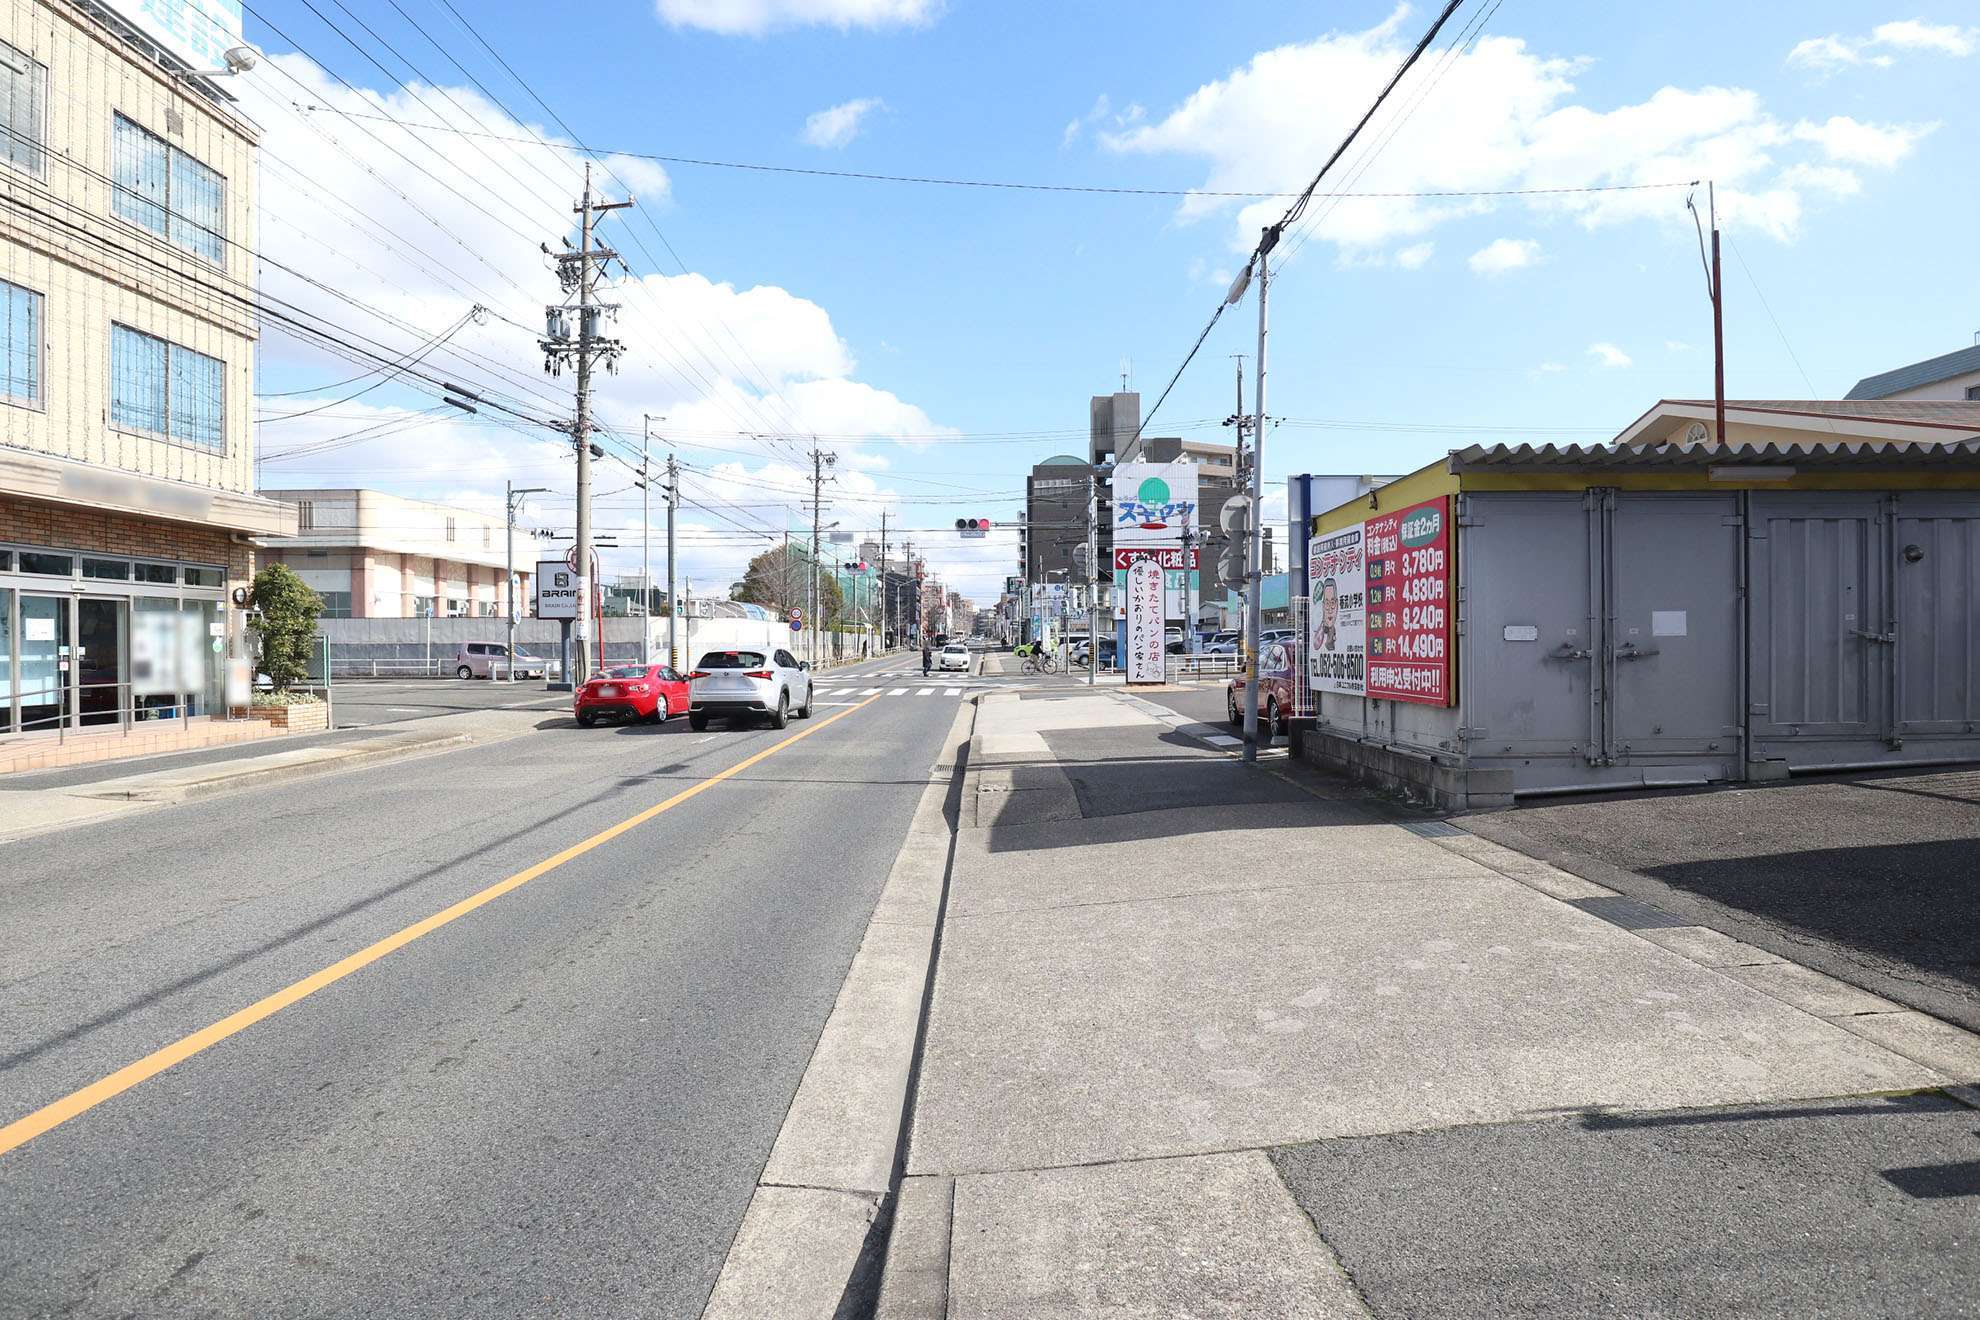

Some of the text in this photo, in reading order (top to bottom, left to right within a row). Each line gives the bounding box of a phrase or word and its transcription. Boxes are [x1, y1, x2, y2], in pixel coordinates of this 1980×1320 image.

[1402, 547, 1444, 577] 3,780円
[1402, 576, 1444, 605] 4,830円
[1148, 568, 1160, 662] 焼きたてパンの店
[1402, 604, 1444, 632] 9,240円
[1398, 633, 1444, 660] 14,490円
[1370, 666, 1440, 694] 利用申込受付中!!
